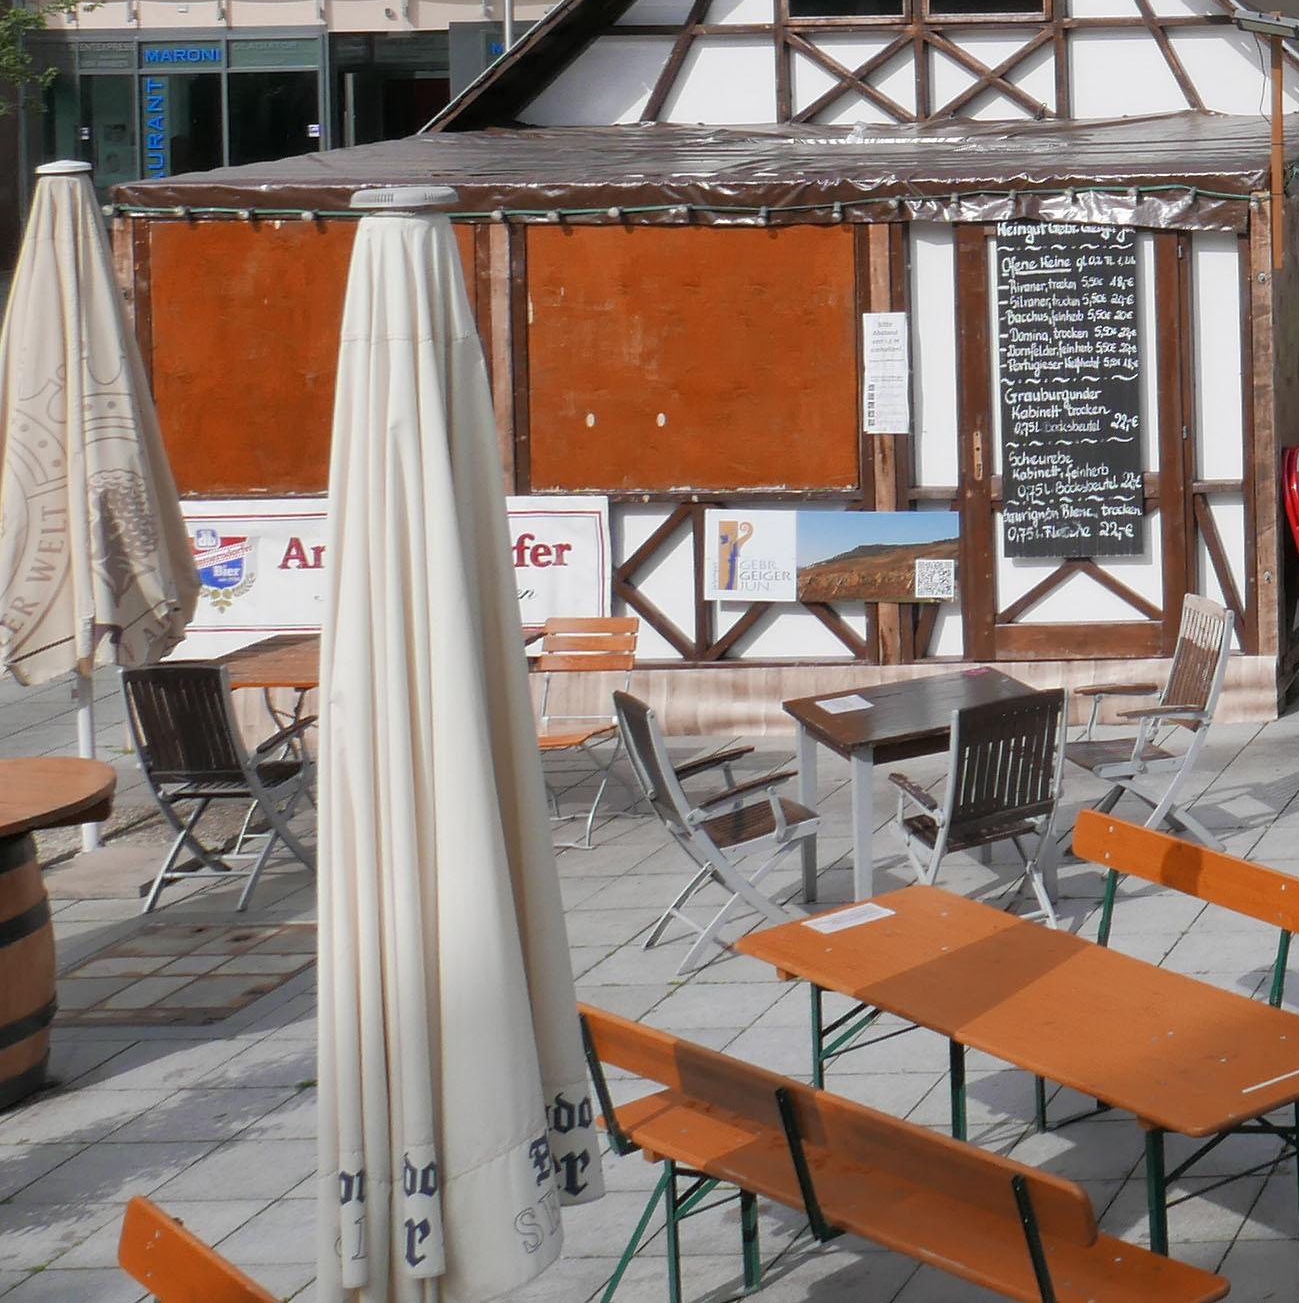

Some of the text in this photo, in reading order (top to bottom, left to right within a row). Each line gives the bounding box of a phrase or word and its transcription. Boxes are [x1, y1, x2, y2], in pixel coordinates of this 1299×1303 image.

[143, 47, 221, 63] MARONI
[1004, 387, 1103, 409] Grauburgunder
[26, 506, 67, 584] WELT
[739, 570, 792, 582] GEIGER
